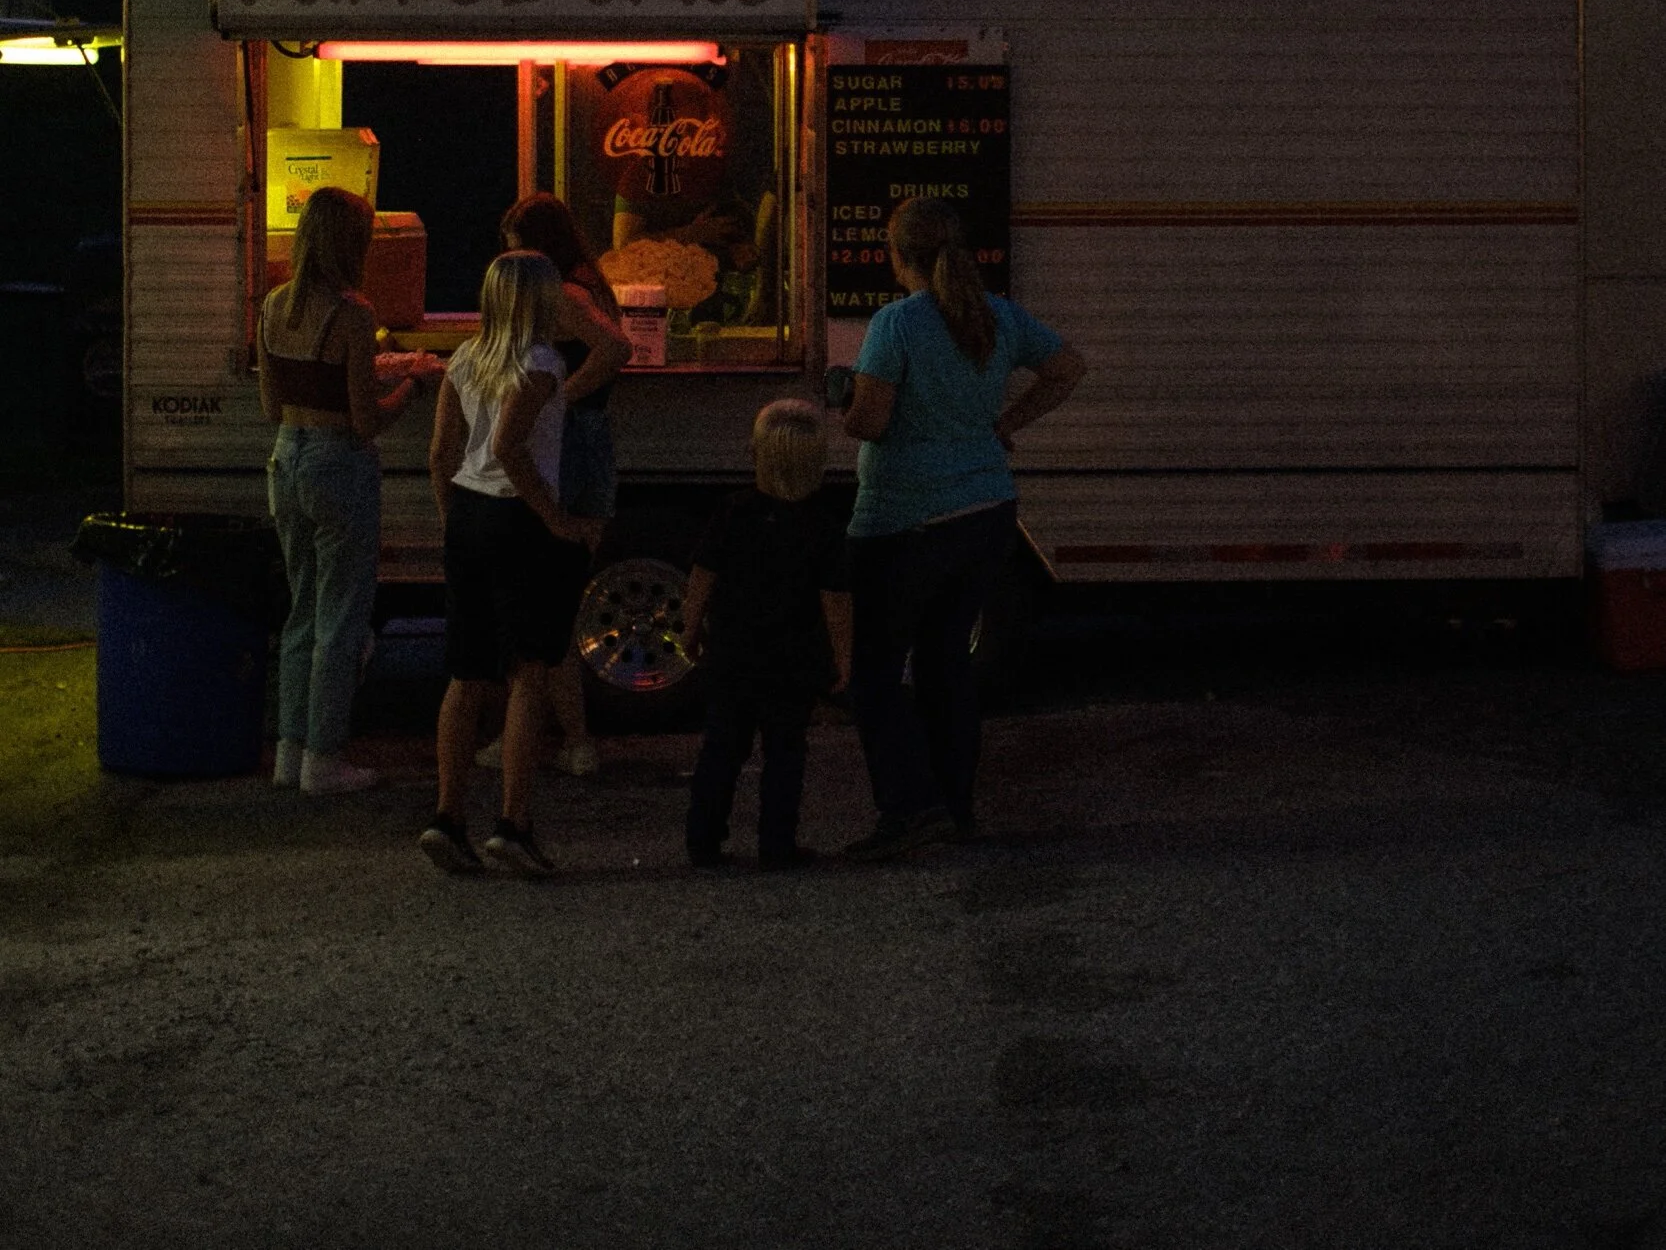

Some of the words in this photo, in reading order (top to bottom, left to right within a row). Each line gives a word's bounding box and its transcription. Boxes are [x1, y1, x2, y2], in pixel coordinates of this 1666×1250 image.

[832, 75, 904, 90] SUGAR
[834, 97, 903, 111] APPLE
[831, 119, 943, 134] CINNAMON
[604, 117, 720, 157] Coca-Cola
[835, 140, 981, 155] STRAWBERRY
[889, 183, 970, 198] DRINKS
[832, 206, 882, 220] ICED
[832, 227, 888, 242] LEMO
[152, 397, 222, 414] KODIAK
